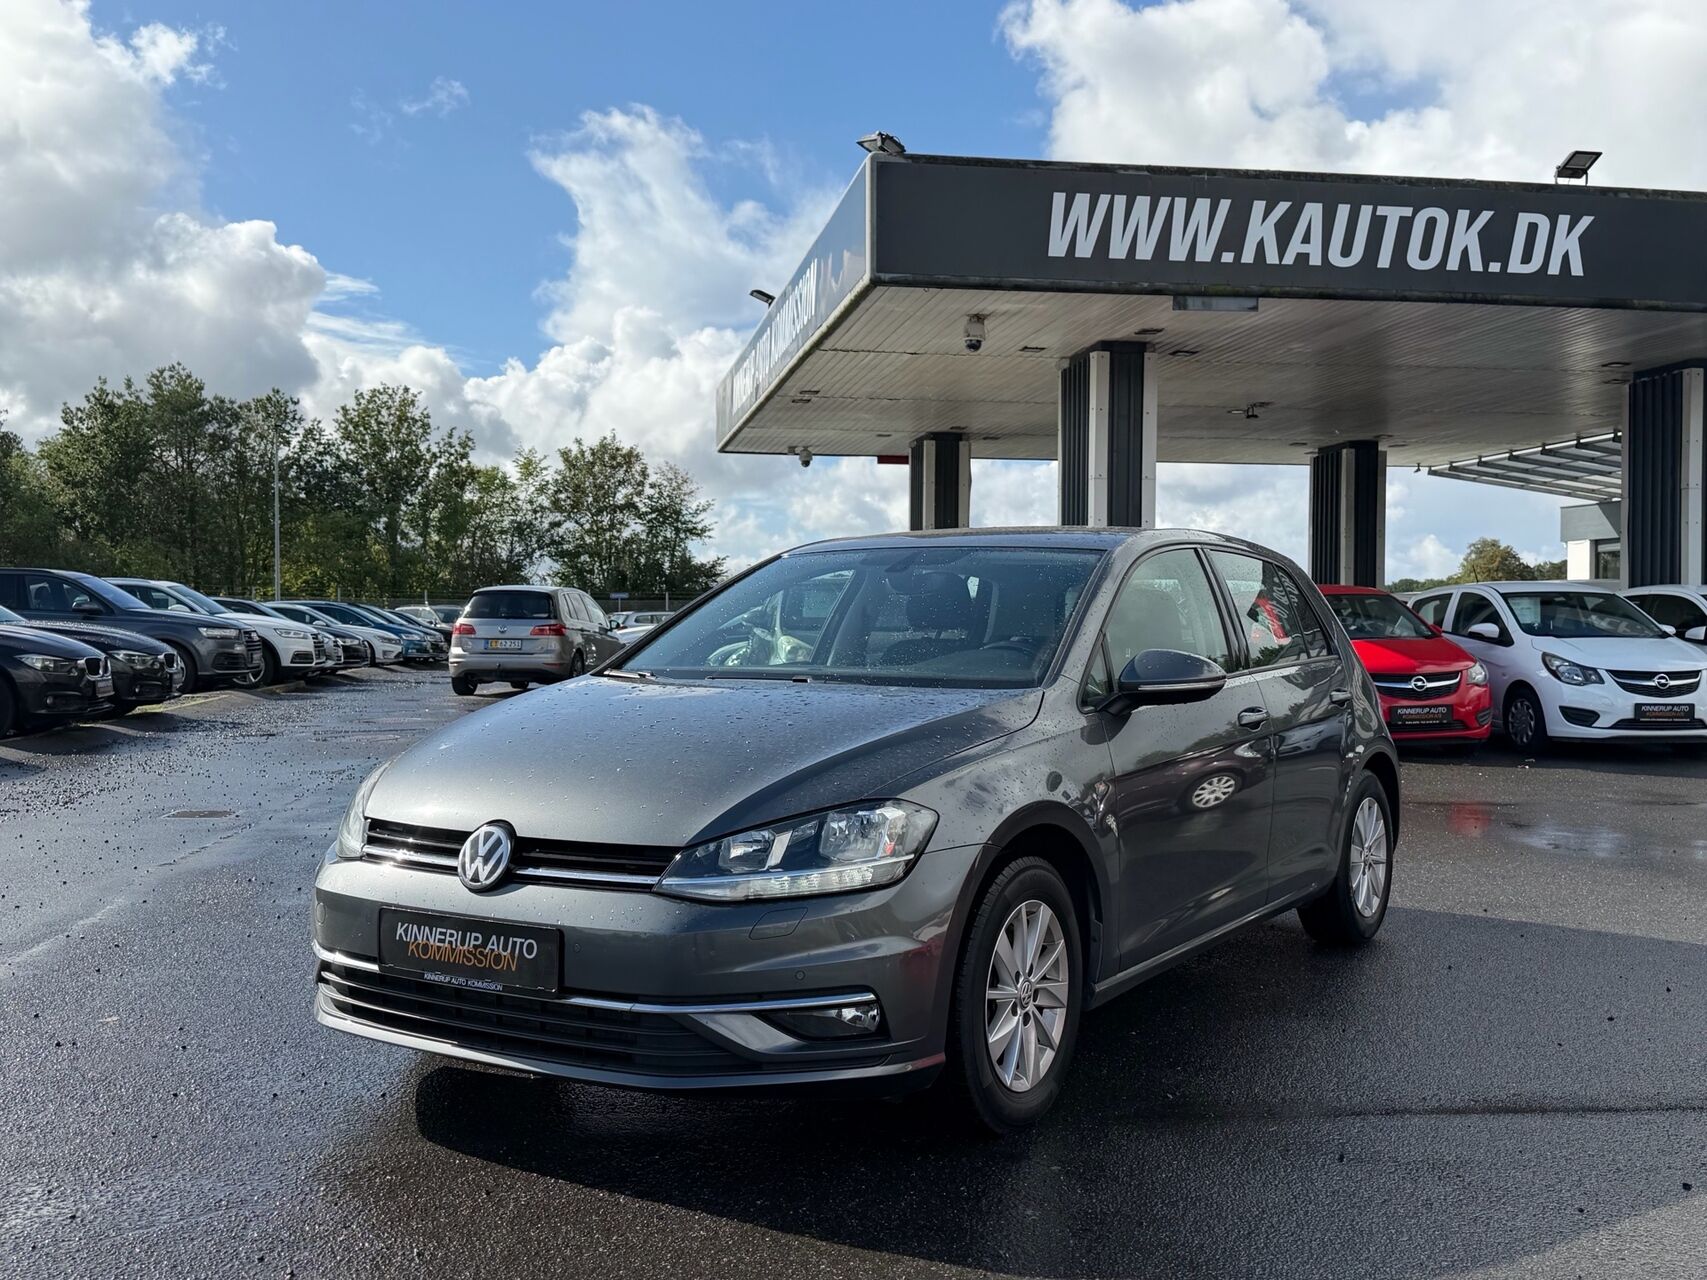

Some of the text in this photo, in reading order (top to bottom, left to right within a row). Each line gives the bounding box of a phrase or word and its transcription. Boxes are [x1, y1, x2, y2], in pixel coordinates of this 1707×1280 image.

[1047, 191, 1596, 277] WWW.KAUTOK.DK
[1397, 706, 1447, 715] KINNERUP AUTO
[396, 922, 538, 959] KINNERUP AUTO
[408, 940, 518, 972] KOMMISSION
[424, 972, 503, 991] KINNERUP AUTO KOMMISSION
